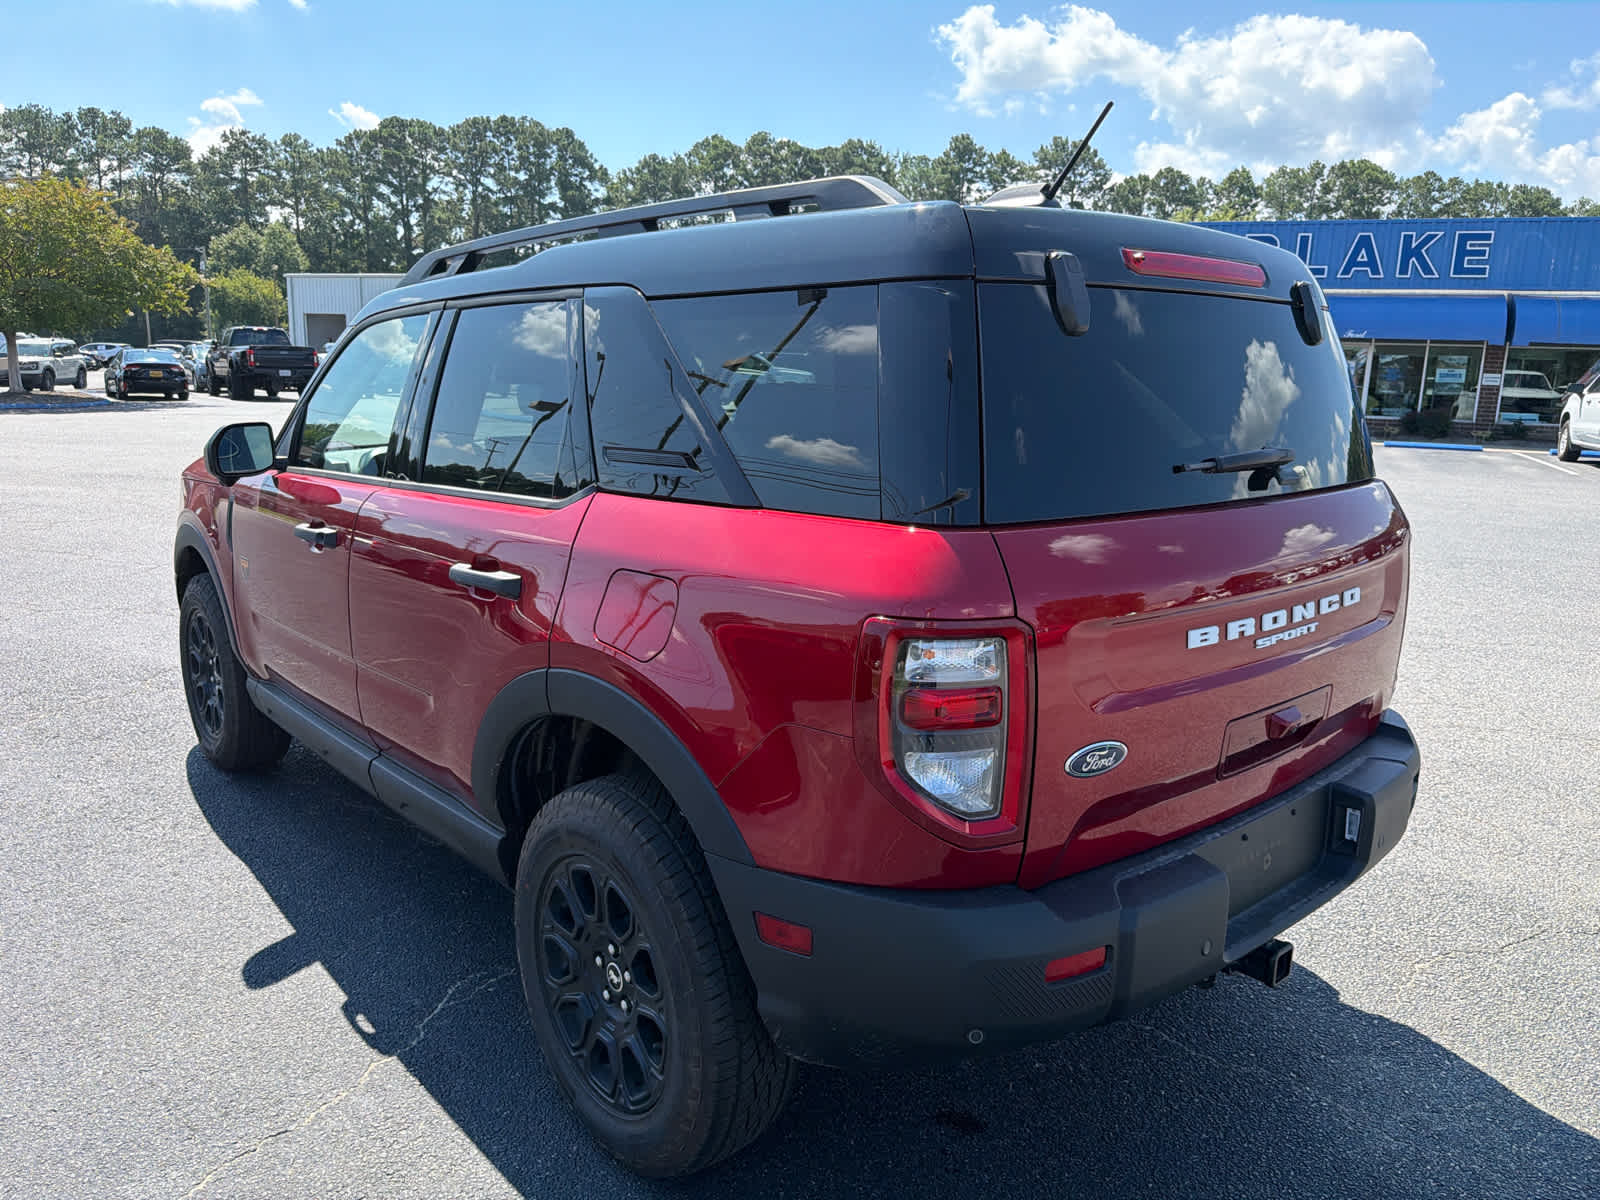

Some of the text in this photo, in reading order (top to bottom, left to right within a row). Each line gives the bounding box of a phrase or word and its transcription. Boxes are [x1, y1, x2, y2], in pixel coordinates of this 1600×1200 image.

[1187, 587, 1361, 649] BRONCO
[1254, 622, 1319, 649] SPORT
[1082, 751, 1116, 772] Ford
